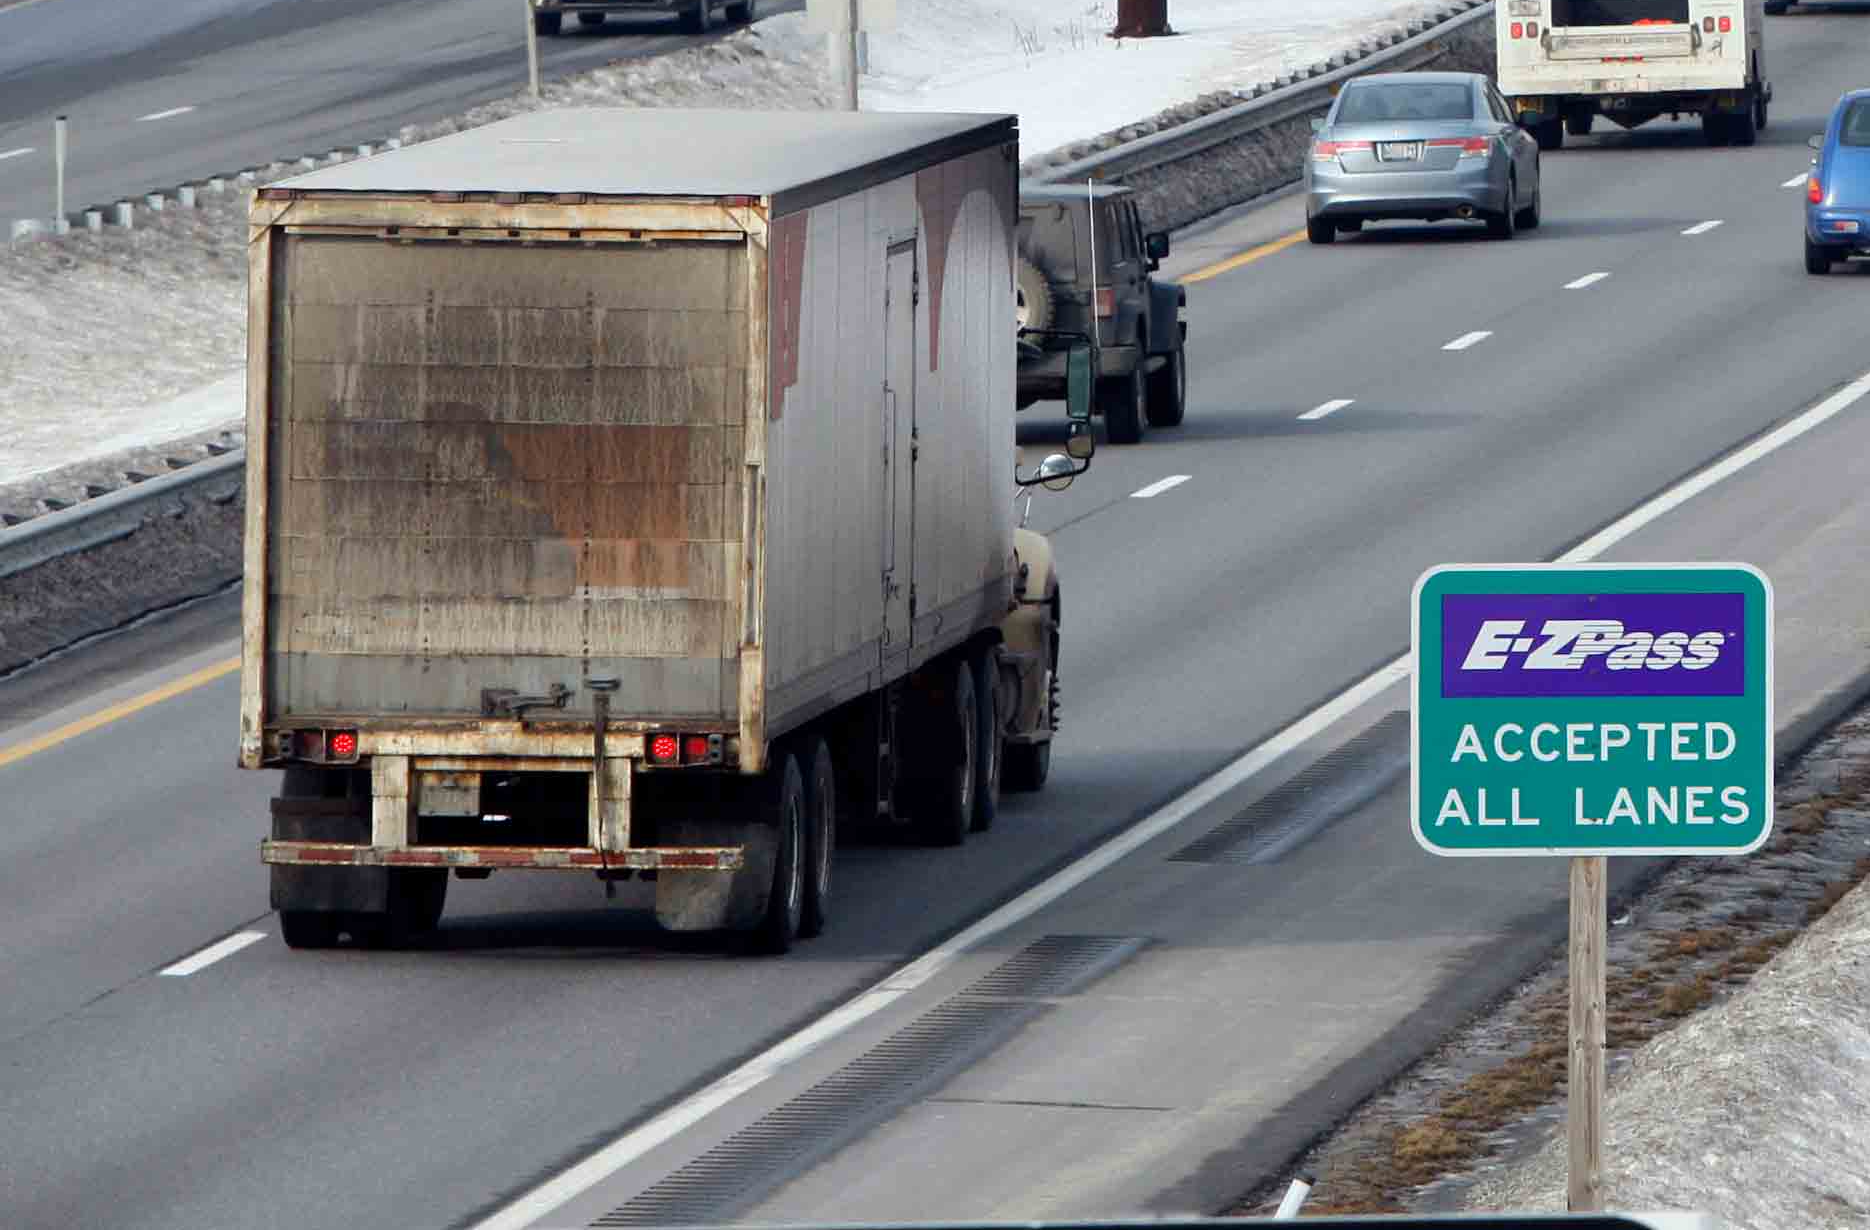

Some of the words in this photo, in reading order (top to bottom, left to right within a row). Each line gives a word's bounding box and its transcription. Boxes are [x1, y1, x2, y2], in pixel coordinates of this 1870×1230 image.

[1460, 619, 1727, 671] E-ZPass
[1451, 722, 1736, 762] ACCEPTED
[1435, 788, 1539, 826] ALL
[1576, 785, 1749, 826] LANES
